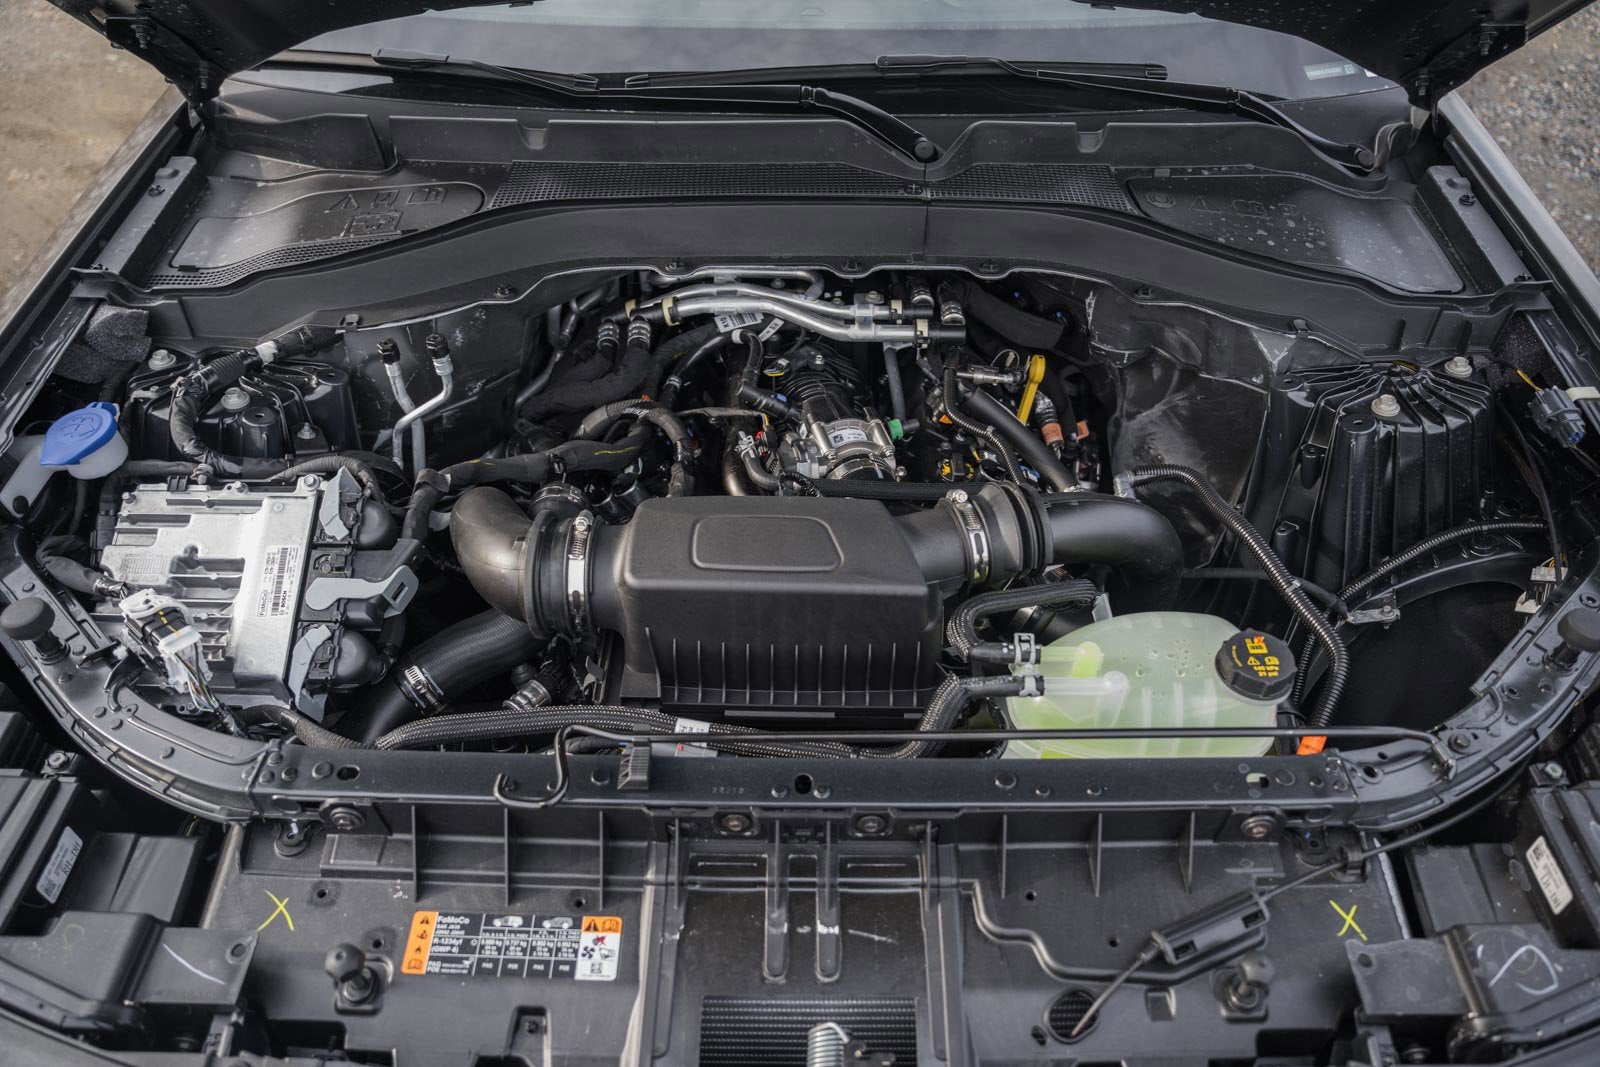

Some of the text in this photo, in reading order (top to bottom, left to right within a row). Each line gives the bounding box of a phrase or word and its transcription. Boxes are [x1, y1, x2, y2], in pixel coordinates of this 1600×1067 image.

[720, 317, 729, 328] K10
[259, 592, 268, 616] FoMoCo
[437, 915, 470, 925] FoMoCo
[433, 937, 463, 946] R-1234yf
